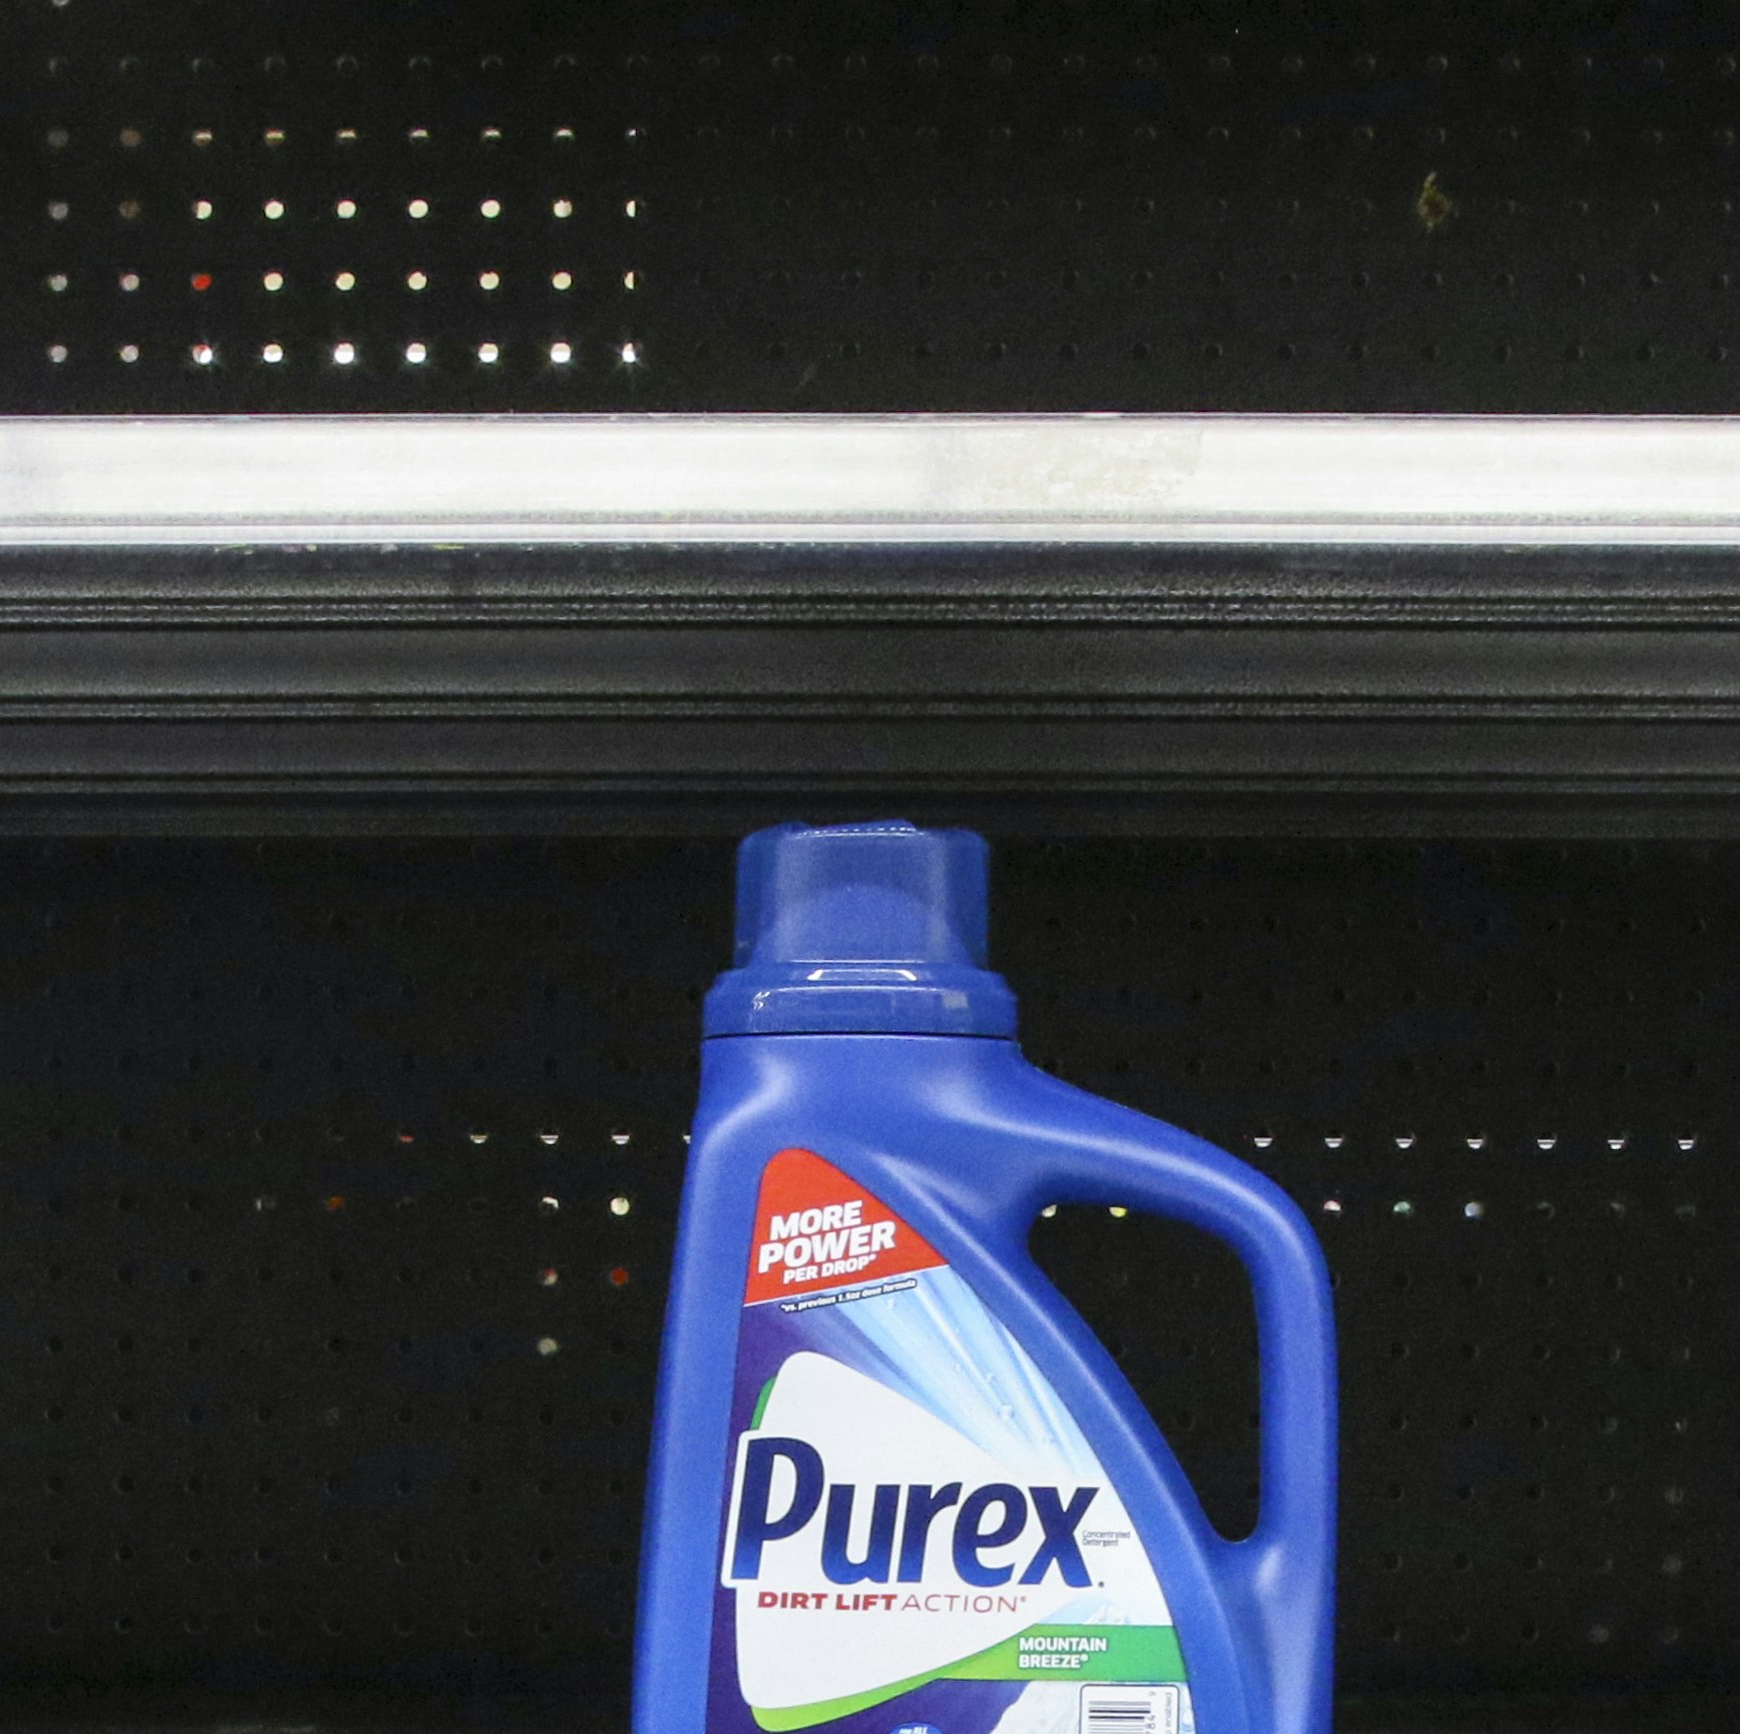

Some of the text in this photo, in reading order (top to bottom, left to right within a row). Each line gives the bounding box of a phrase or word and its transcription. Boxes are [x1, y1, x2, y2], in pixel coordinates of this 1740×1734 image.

[770, 1200, 863, 1240] MORE
[758, 1220, 896, 1273] POWER
[782, 1265, 819, 1284] PER
[730, 1436, 1101, 1588] Purex
[758, 1592, 829, 1610] DIRT
[835, 1593, 898, 1611] LIFT
[1019, 1637, 1107, 1652] MOUNTAIN
